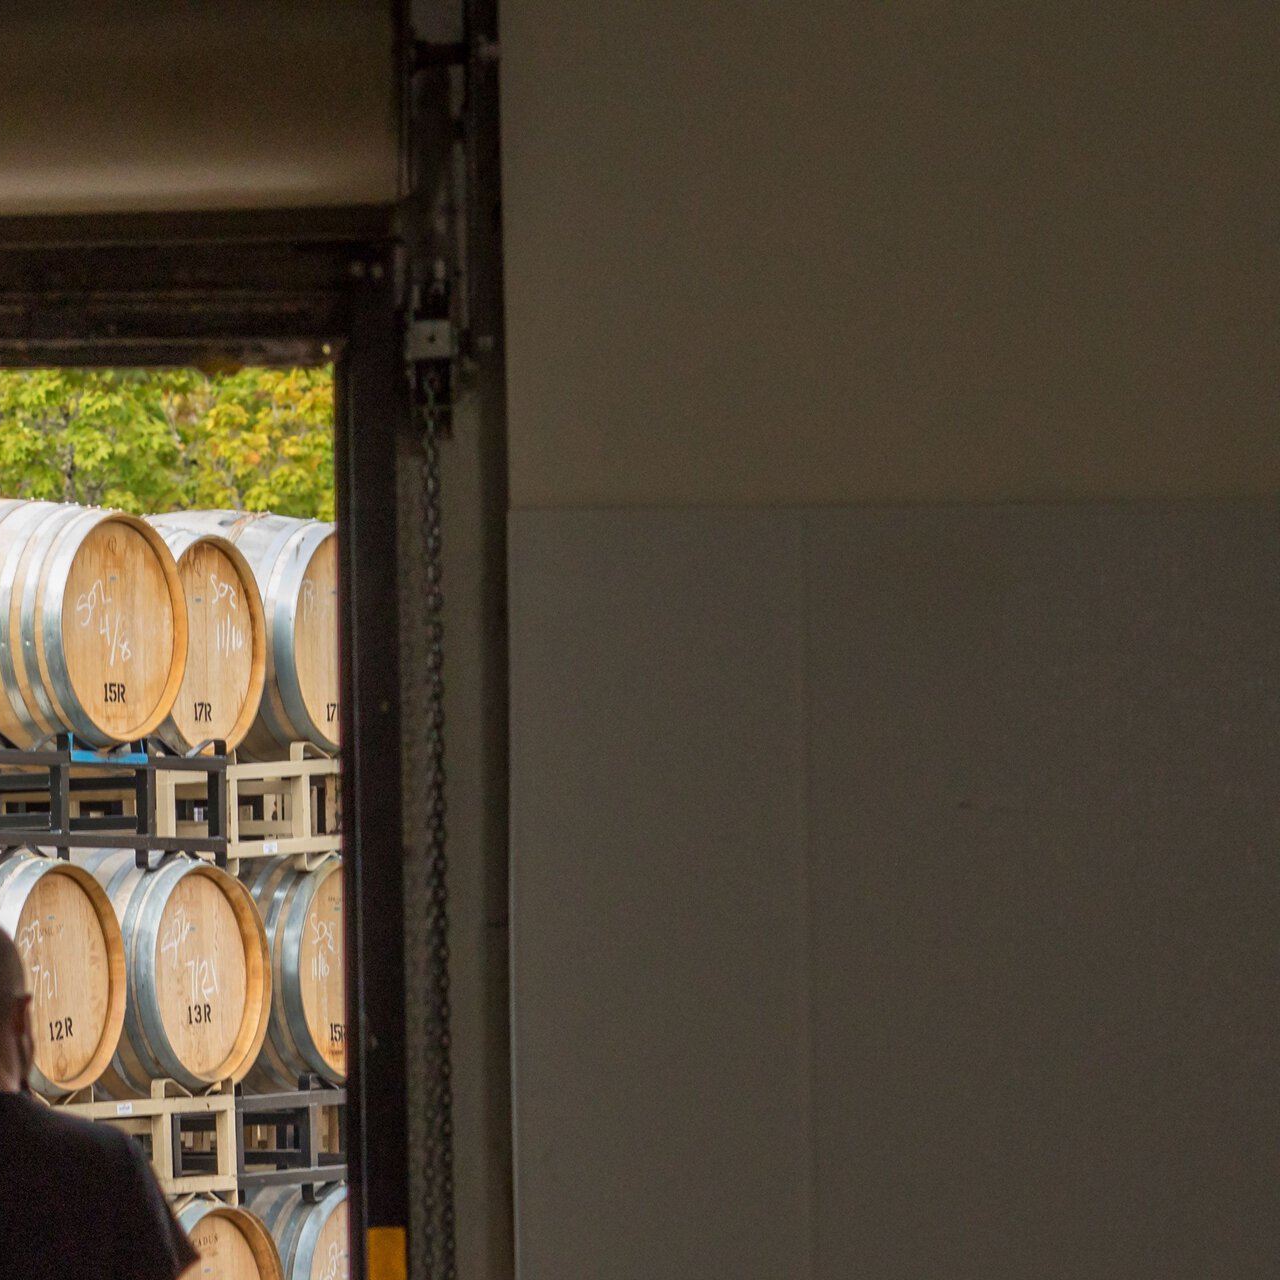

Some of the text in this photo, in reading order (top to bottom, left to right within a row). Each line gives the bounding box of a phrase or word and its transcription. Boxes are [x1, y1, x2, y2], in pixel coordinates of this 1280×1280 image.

[103, 682, 126, 704] 15R
[193, 701, 212, 723] 17R
[187, 1003, 212, 1025] 13R
[49, 1016, 74, 1041] 12R
